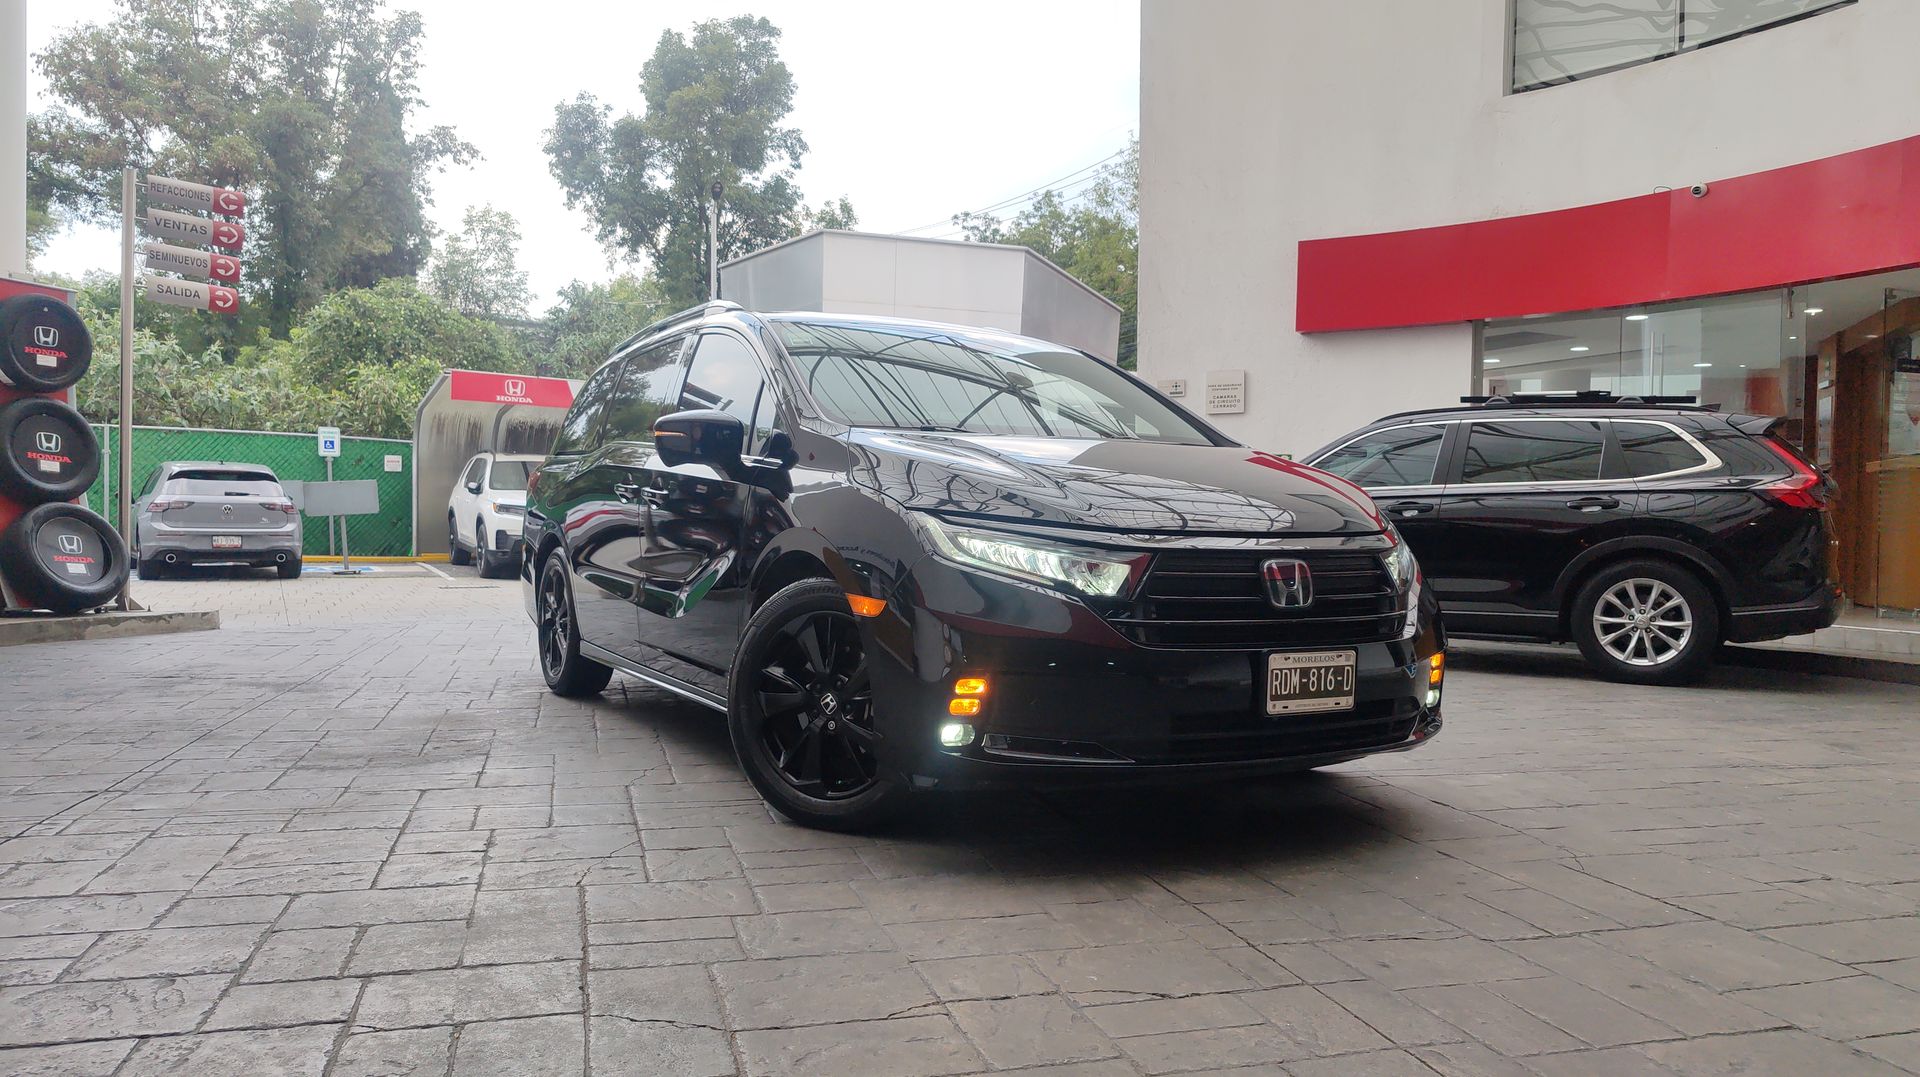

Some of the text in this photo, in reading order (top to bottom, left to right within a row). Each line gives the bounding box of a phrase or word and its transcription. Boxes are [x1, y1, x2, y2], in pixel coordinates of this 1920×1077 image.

[150, 182, 211, 202] REFACCIONES
[154, 217, 208, 235] VENTAS
[149, 250, 208, 269] SEMINUEVOS
[156, 284, 201, 299] SALIDA
[24, 346, 68, 358] HONDA
[496, 395, 533, 404] HONDA
[26, 451, 72, 463] HONDA
[53, 555, 95, 564] HONDA
[1292, 655, 1336, 664] MORELOS
[1272, 666, 1351, 695] RDM-816-D
